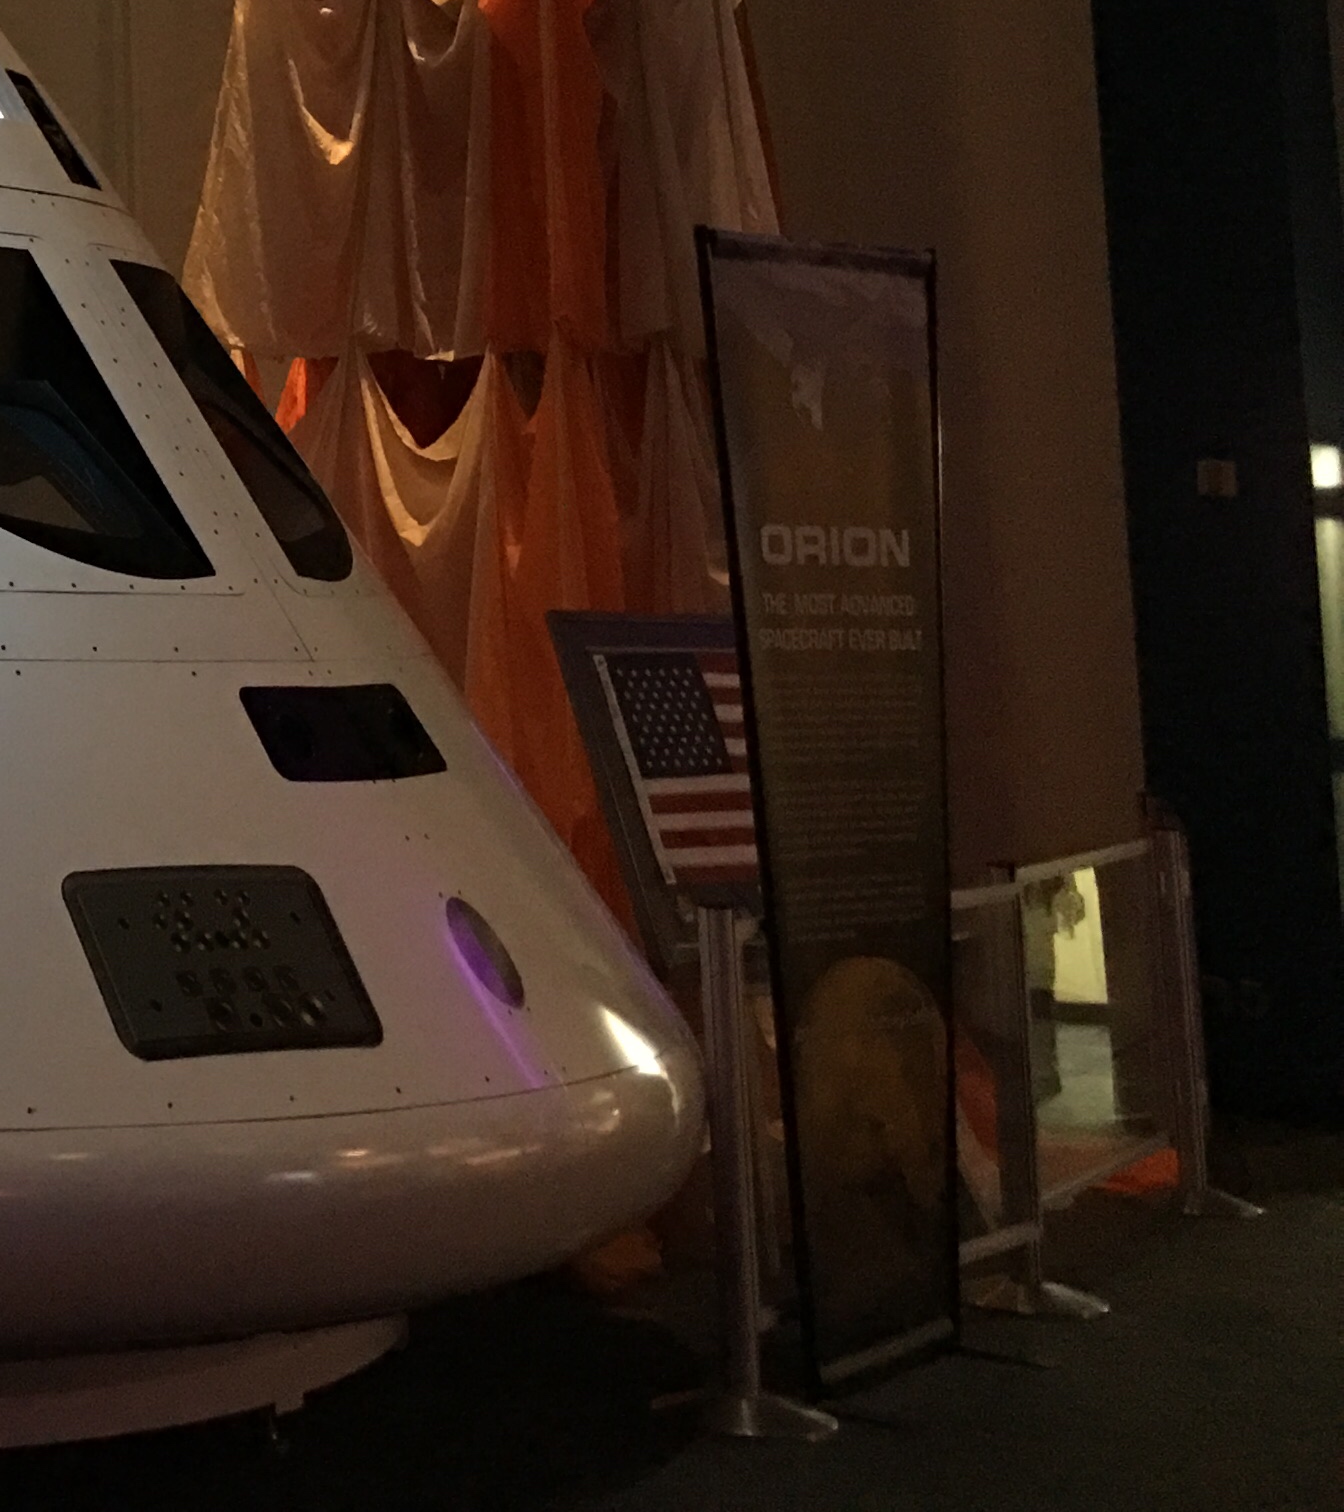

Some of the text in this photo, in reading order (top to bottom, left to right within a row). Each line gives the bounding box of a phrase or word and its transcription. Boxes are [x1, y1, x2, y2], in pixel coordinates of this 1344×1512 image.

[760, 524, 911, 568] ORION
[762, 592, 916, 617] THE MOST ADVANCED
[759, 627, 923, 652] SPACECRAFT EVER BUILT
